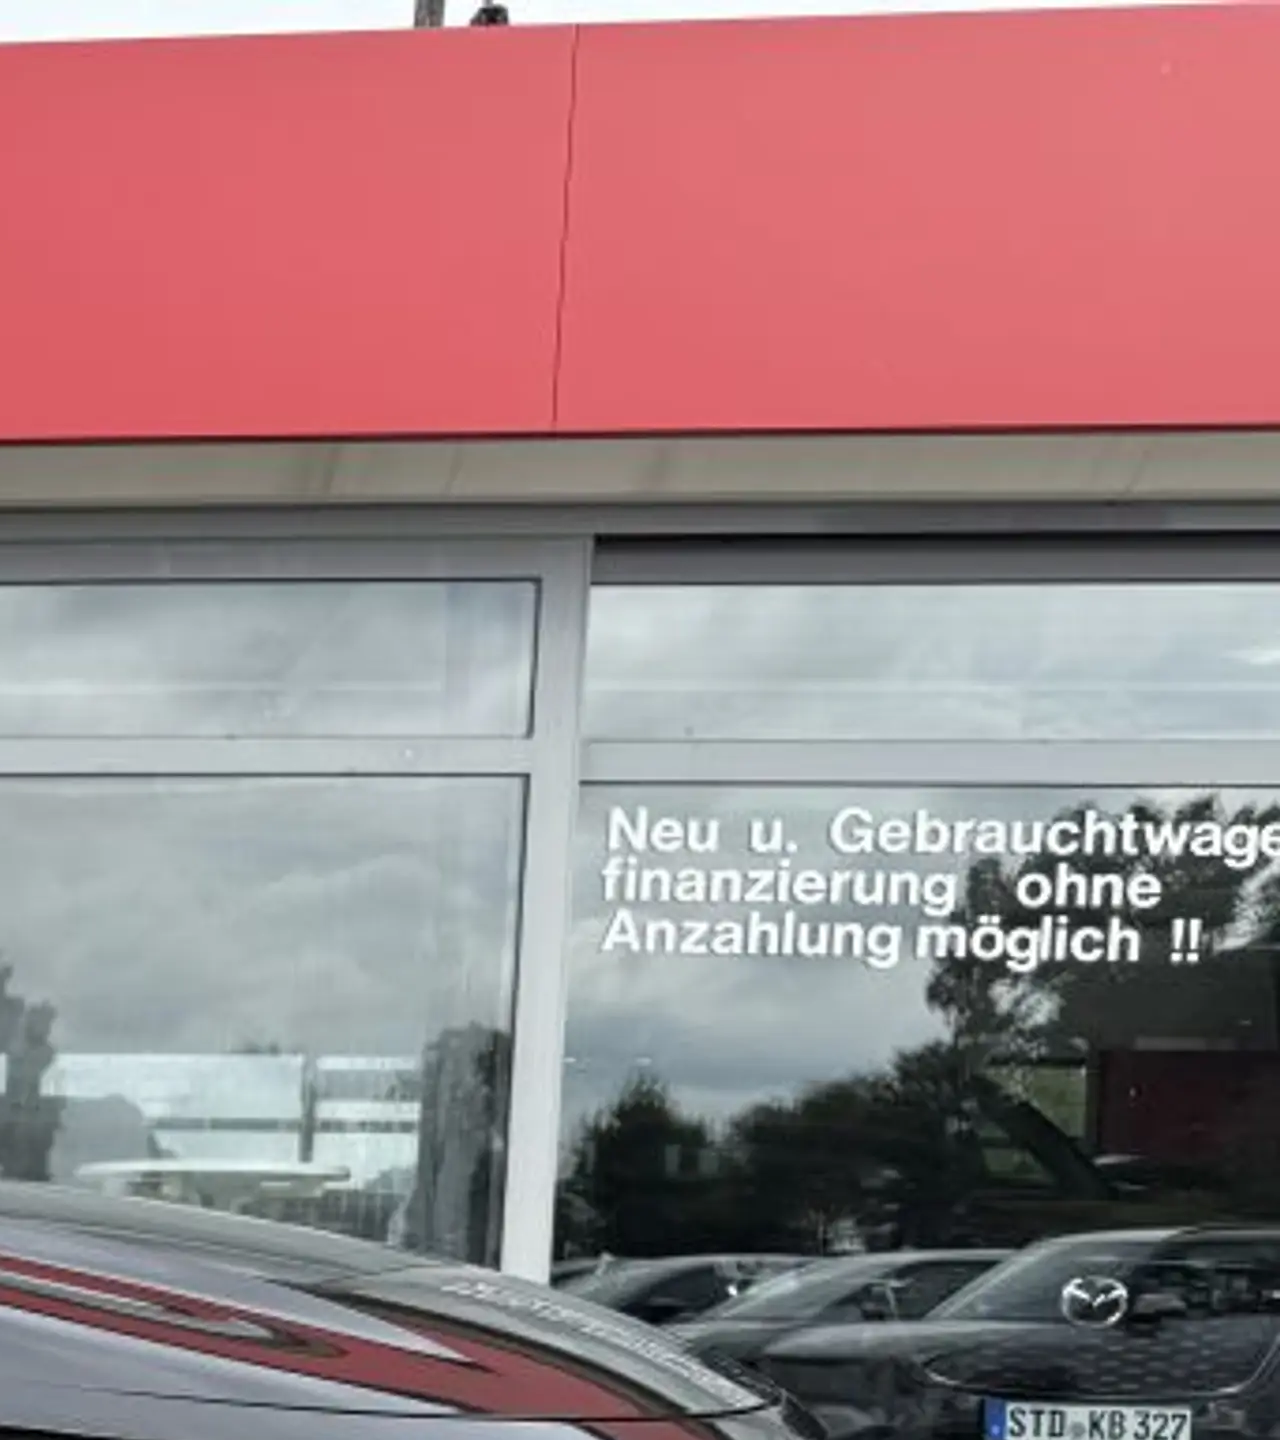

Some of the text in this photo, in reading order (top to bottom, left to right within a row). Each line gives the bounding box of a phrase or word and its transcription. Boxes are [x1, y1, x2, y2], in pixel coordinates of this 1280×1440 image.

[607, 805, 720, 851] Neu
[749, 817, 799, 852] u.
[601, 855, 1162, 917] finanzierung ohne
[600, 907, 902, 969] Anzahlung
[915, 914, 1141, 972] möglich
[1008, 1408, 1066, 1439] STD
[1089, 1409, 1127, 1440] KB
